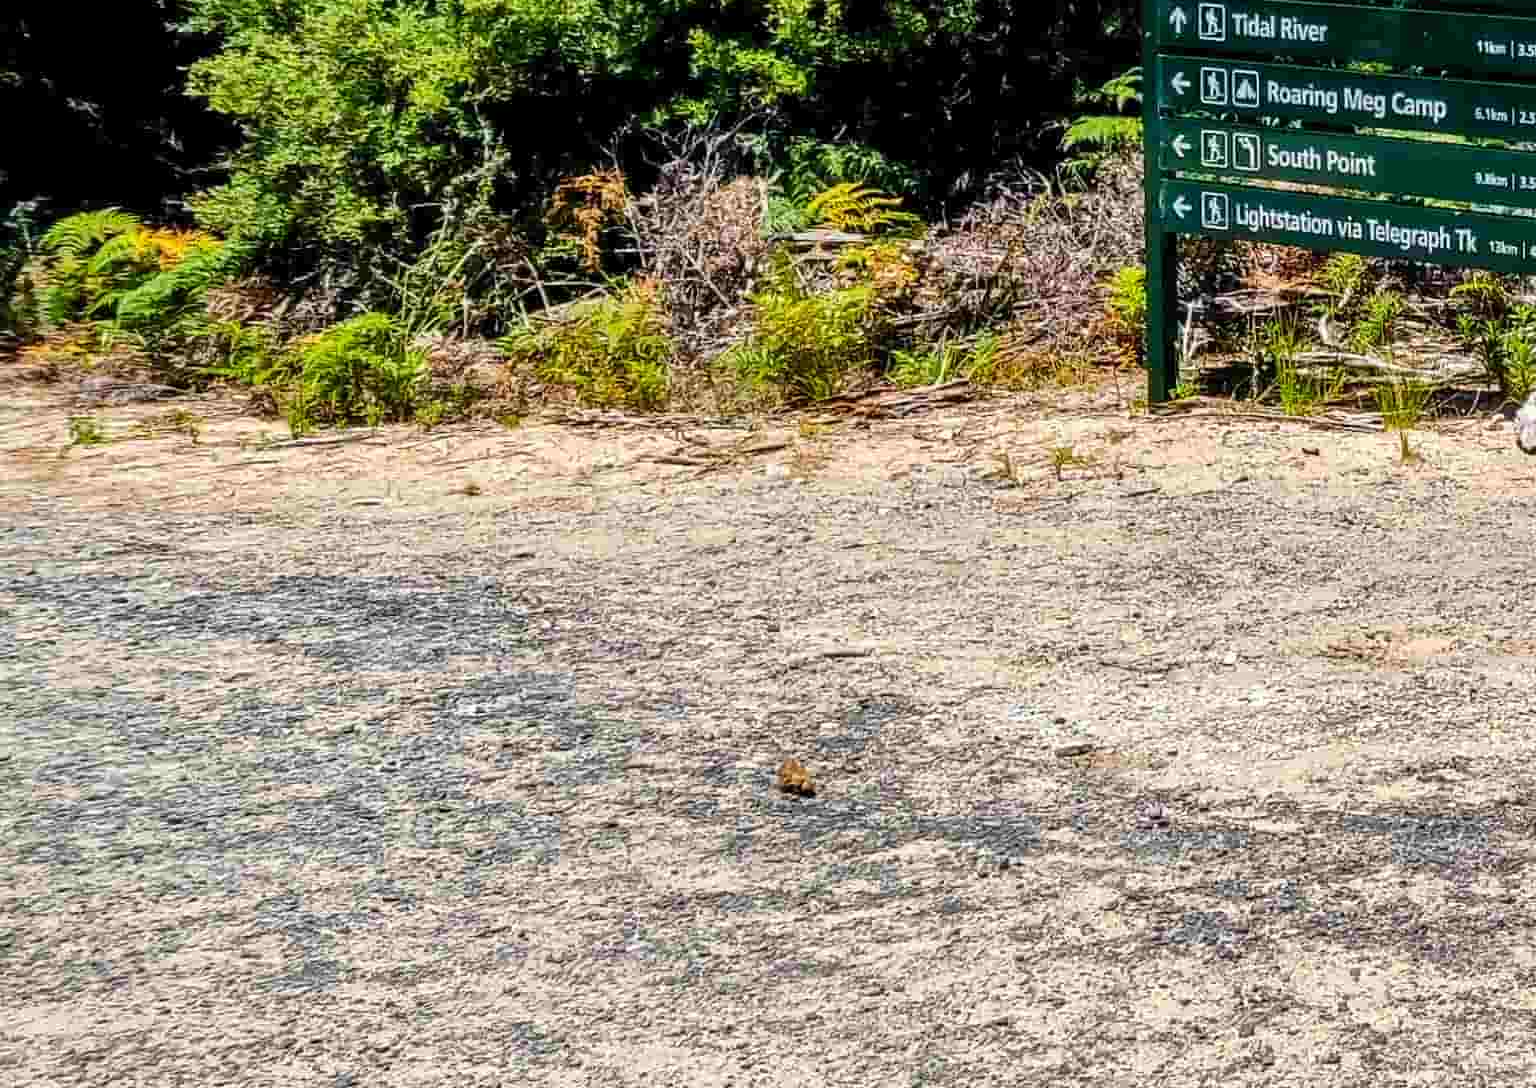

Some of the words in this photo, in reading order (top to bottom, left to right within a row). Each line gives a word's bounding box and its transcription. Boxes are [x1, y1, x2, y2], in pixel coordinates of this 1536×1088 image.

[1231, 13, 1276, 38] Tidal
[1280, 17, 1329, 43] River
[1476, 39, 1507, 56] 11km
[1267, 79, 1338, 114] Roaring
[1343, 87, 1386, 119] Meg
[1391, 92, 1448, 124] Camp
[1474, 107, 1509, 121] 6.1km
[1267, 143, 1322, 171] South
[1326, 150, 1376, 176] Point
[1235, 203, 1333, 236] Lightstation
[1336, 216, 1363, 240] via
[1366, 218, 1451, 254] Telegraph
[1454, 228, 1478, 254] Tk
